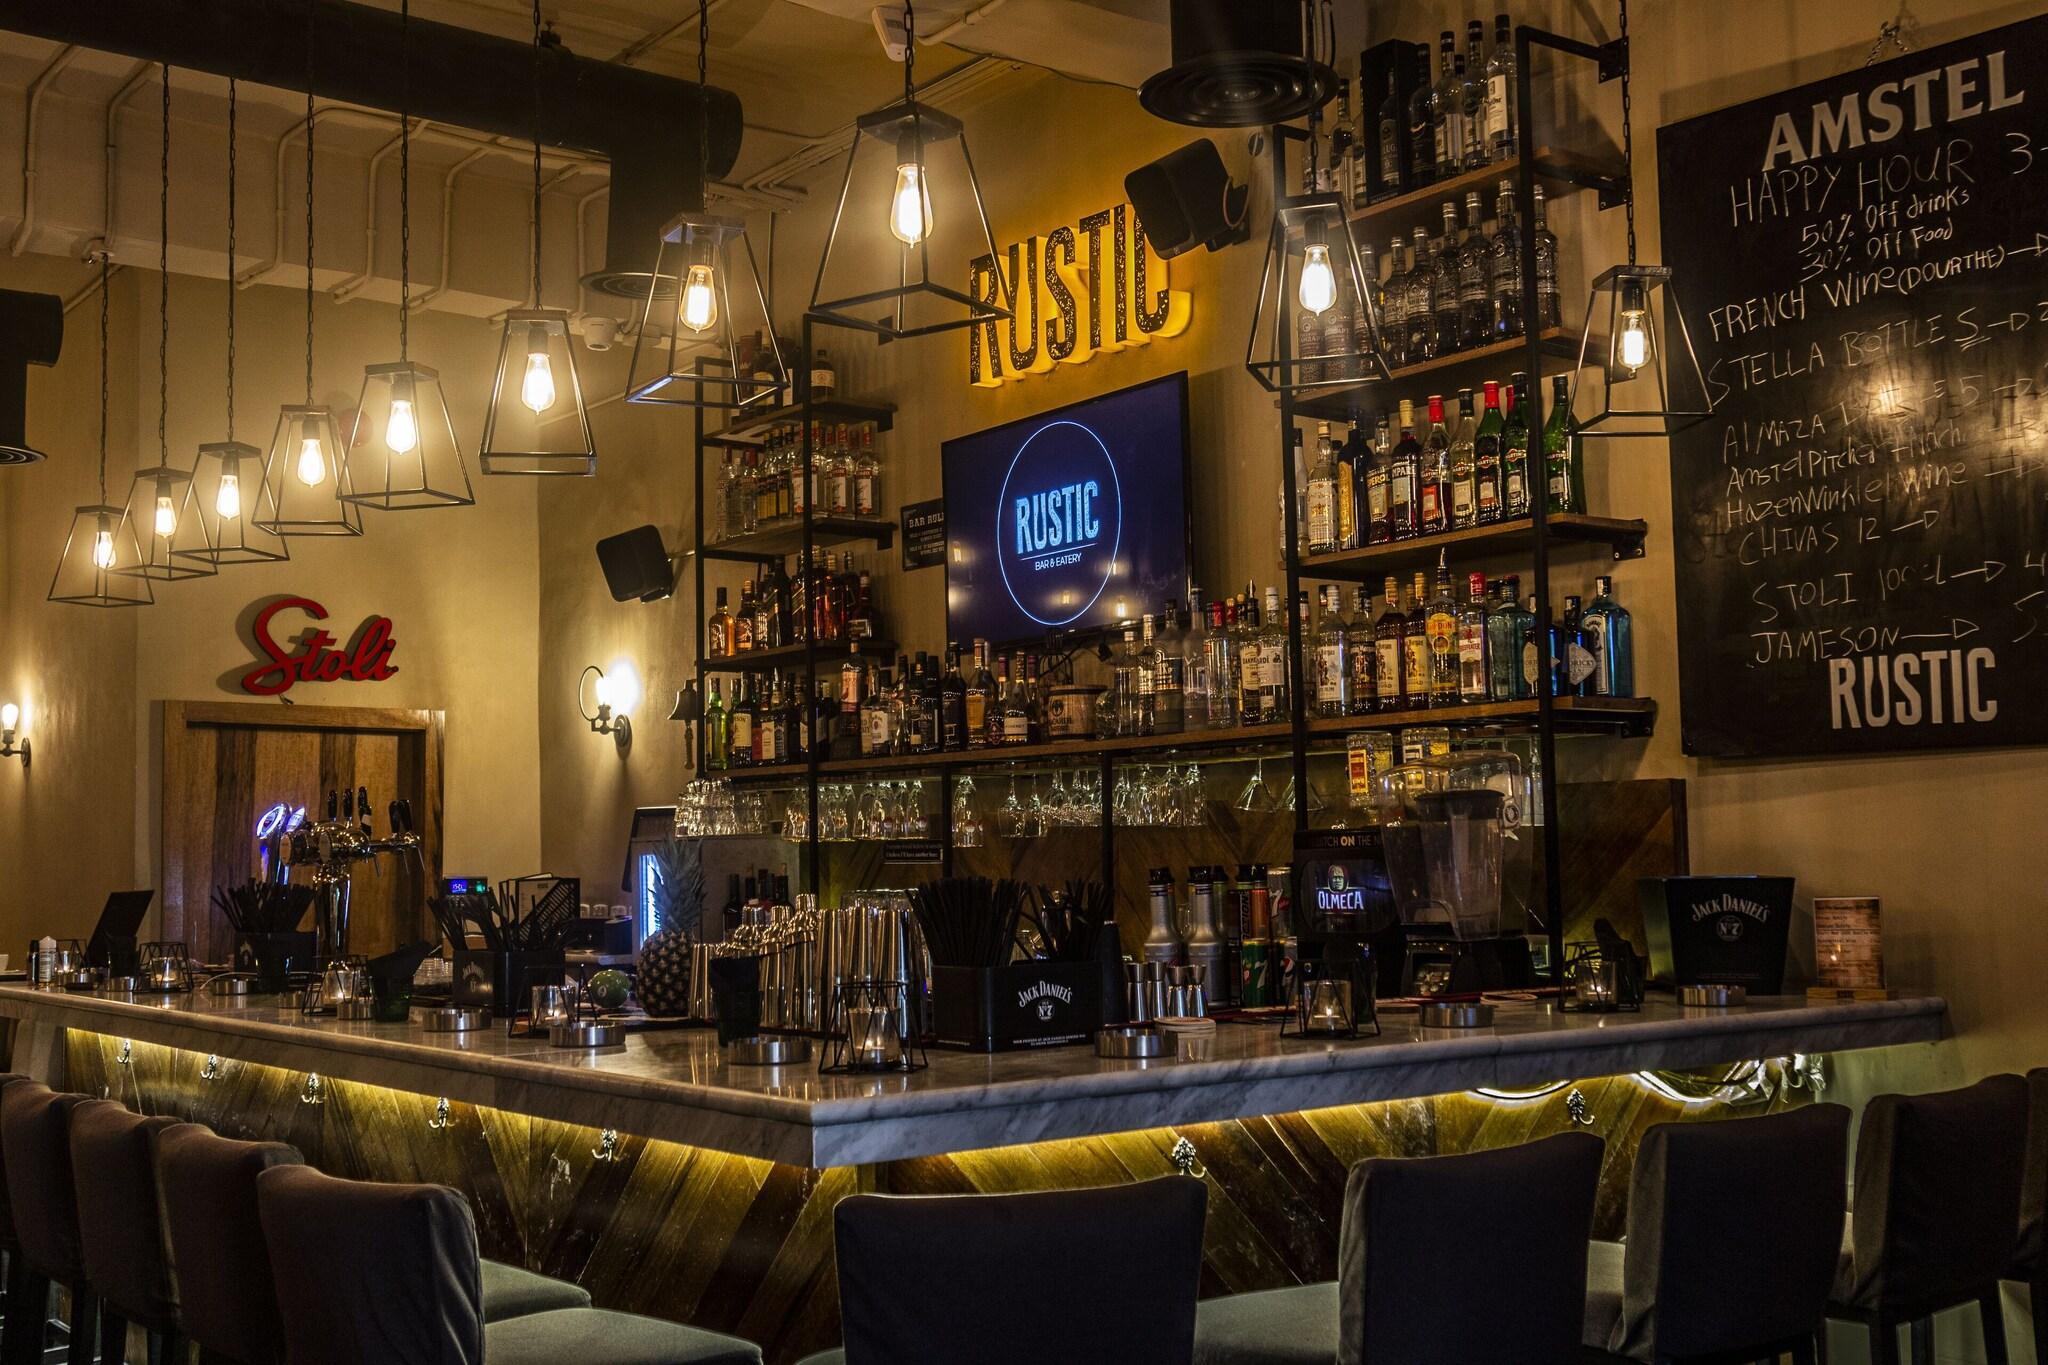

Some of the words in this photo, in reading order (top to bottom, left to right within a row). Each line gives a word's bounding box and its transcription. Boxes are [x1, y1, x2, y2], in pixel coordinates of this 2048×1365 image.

[1761, 50, 2025, 172] AMSTEL
[1730, 165, 1842, 228] HAPPY
[1858, 138, 1976, 211] HOUR
[969, 203, 1174, 387] RUSTIC
[1708, 284, 1807, 342] FRENCH
[1705, 340, 1826, 408] STELLA
[1016, 480, 1099, 555] RUSTIC
[1738, 521, 1839, 566] CHIVAS
[1858, 517, 1881, 544] 12
[1055, 552, 1082, 567] EATERY
[1752, 572, 1858, 623] STOLI
[241, 597, 399, 695] Stoli
[1750, 625, 1901, 665] JAMESON
[1828, 646, 1999, 730] RUSTIC
[1340, 835, 1356, 847] ON
[1317, 890, 1365, 911] OLMECA
[1691, 899, 1721, 923] JACK
[1017, 983, 1041, 1008] JACK
